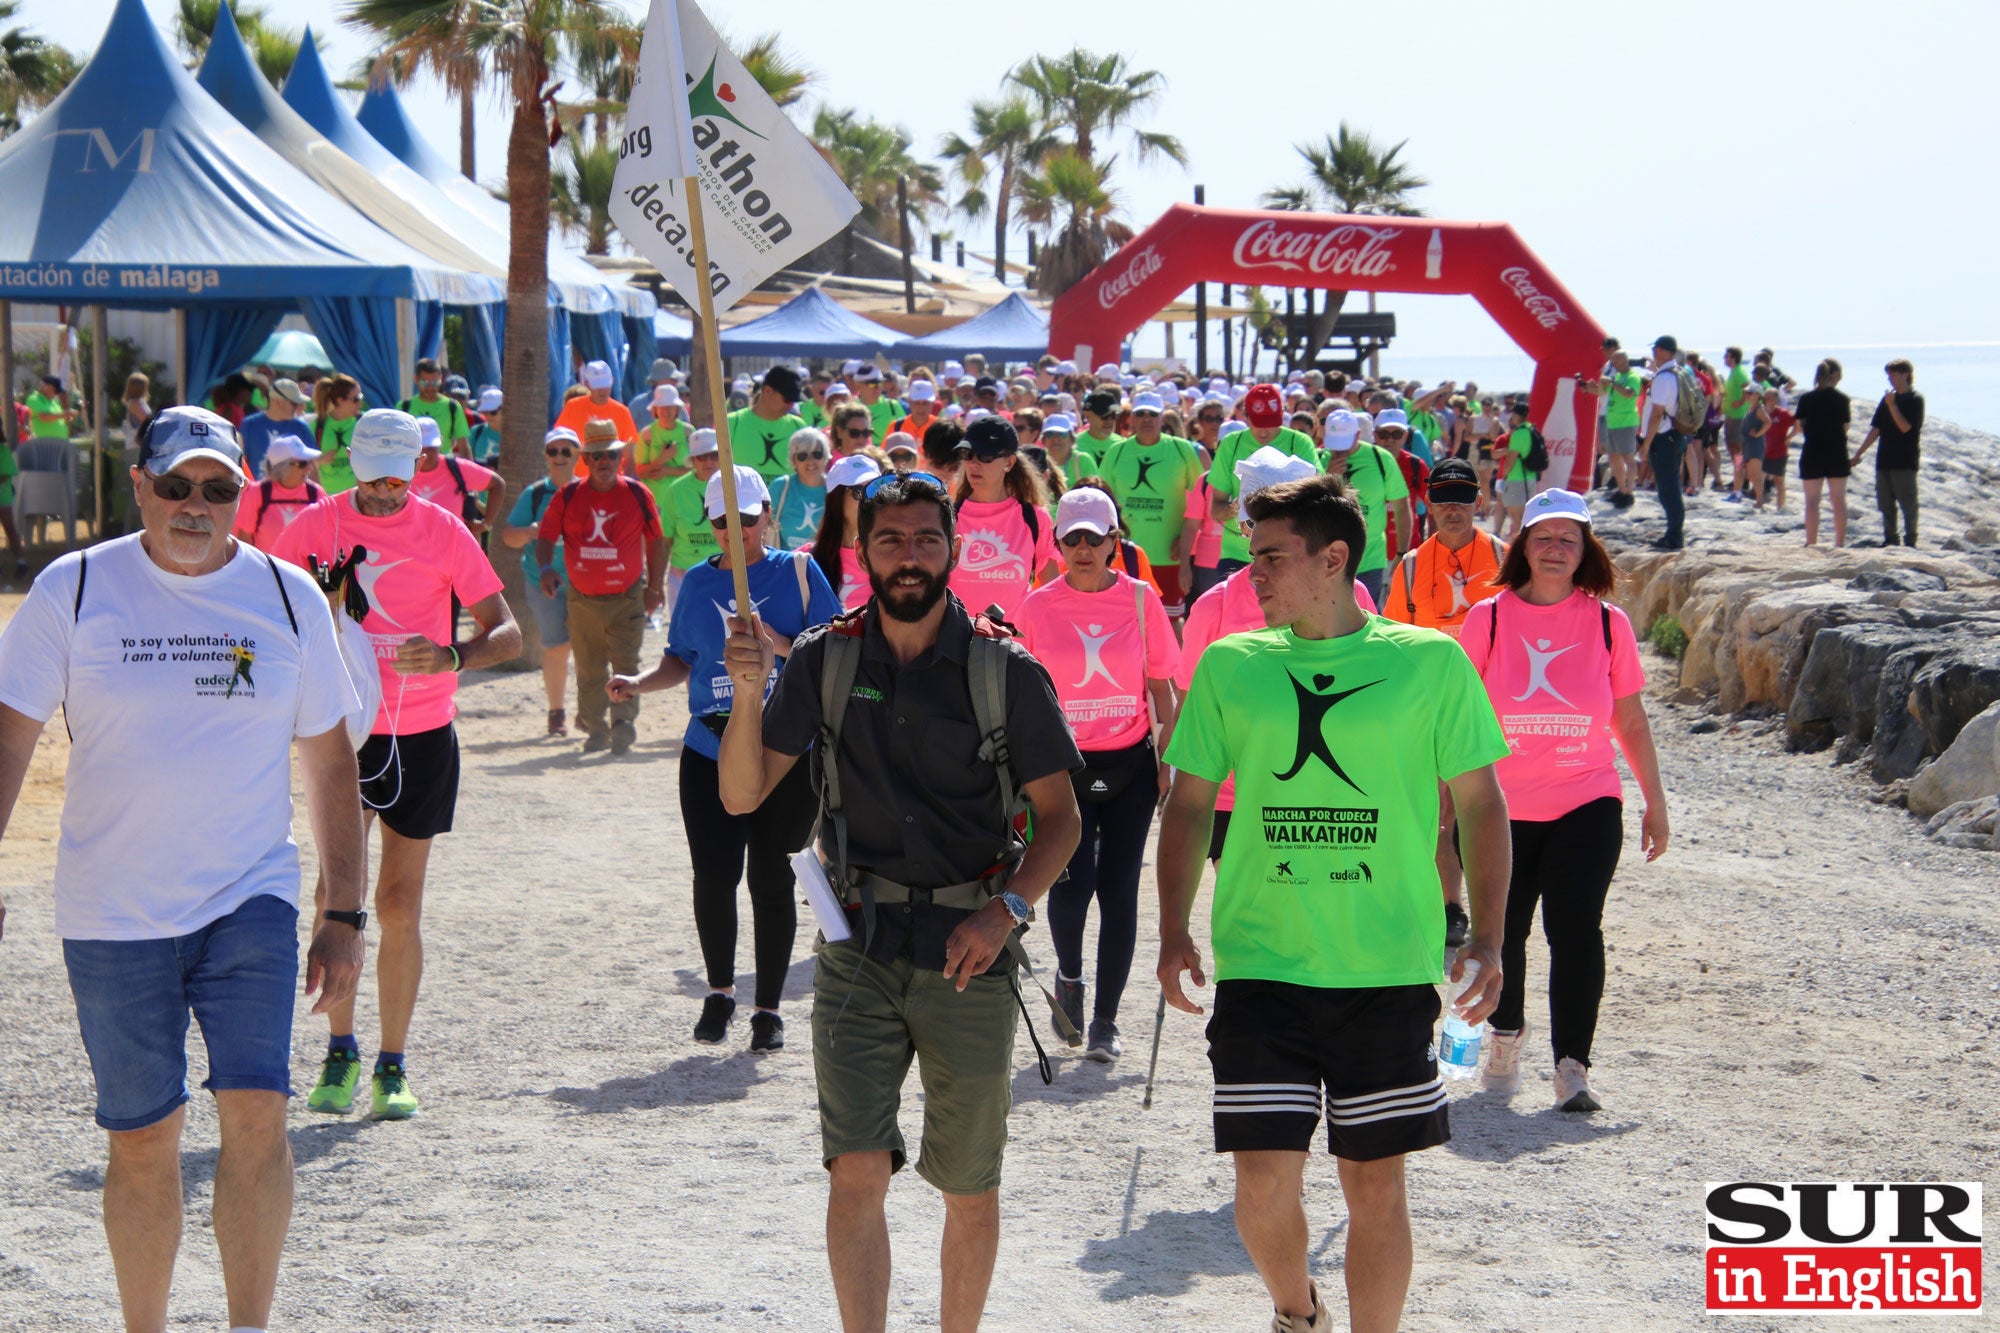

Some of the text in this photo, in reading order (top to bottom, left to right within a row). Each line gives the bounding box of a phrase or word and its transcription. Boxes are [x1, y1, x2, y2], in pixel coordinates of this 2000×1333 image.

[686, 72, 792, 245] athon
[696, 154, 722, 190] DADOS
[723, 194, 738, 213] DEL
[711, 193, 732, 218] CARE
[732, 220, 767, 254] HOSPICE
[1233, 220, 1404, 284] Coca-Cola
[83, 264, 110, 287] de
[121, 263, 219, 292] málaga
[970, 542, 995, 561] 30
[979, 570, 1016, 579] cudeca
[121, 633, 256, 649] Yo soy voluntario de
[131, 652, 153, 662] am
[158, 652, 167, 662] a
[172, 650, 236, 662] volunteer
[195, 674, 239, 686] cudeca
[1066, 706, 1136, 722] WALKATHON
[1504, 716, 1537, 724] MARCHA
[1557, 716, 1587, 724] CUDECA
[1504, 724, 1589, 737] WALKATHON
[1264, 809, 1373, 822] MARCHA POR CUDECA
[1263, 825, 1377, 844] WALKATHON
